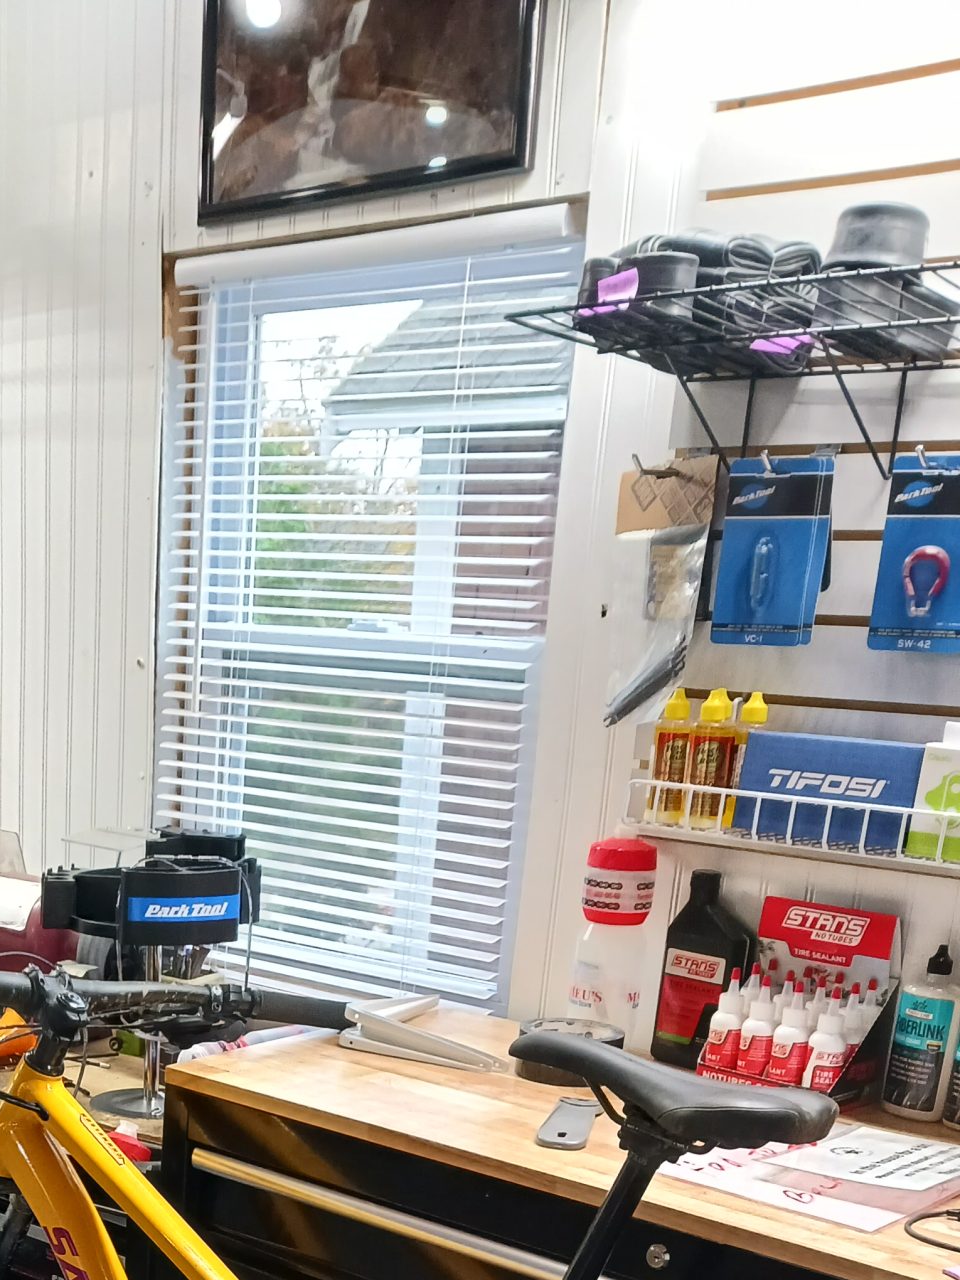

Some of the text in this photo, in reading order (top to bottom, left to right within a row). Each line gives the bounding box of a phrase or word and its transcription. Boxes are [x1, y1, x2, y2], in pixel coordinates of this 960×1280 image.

[897, 638, 932, 649] SW-42
[768, 768, 887, 798] TIFOSI
[144, 901, 229, 918] Park Tool
[794, 948, 847, 964] TIRE SEALANT
[816, 1070, 834, 1078] TIRE
